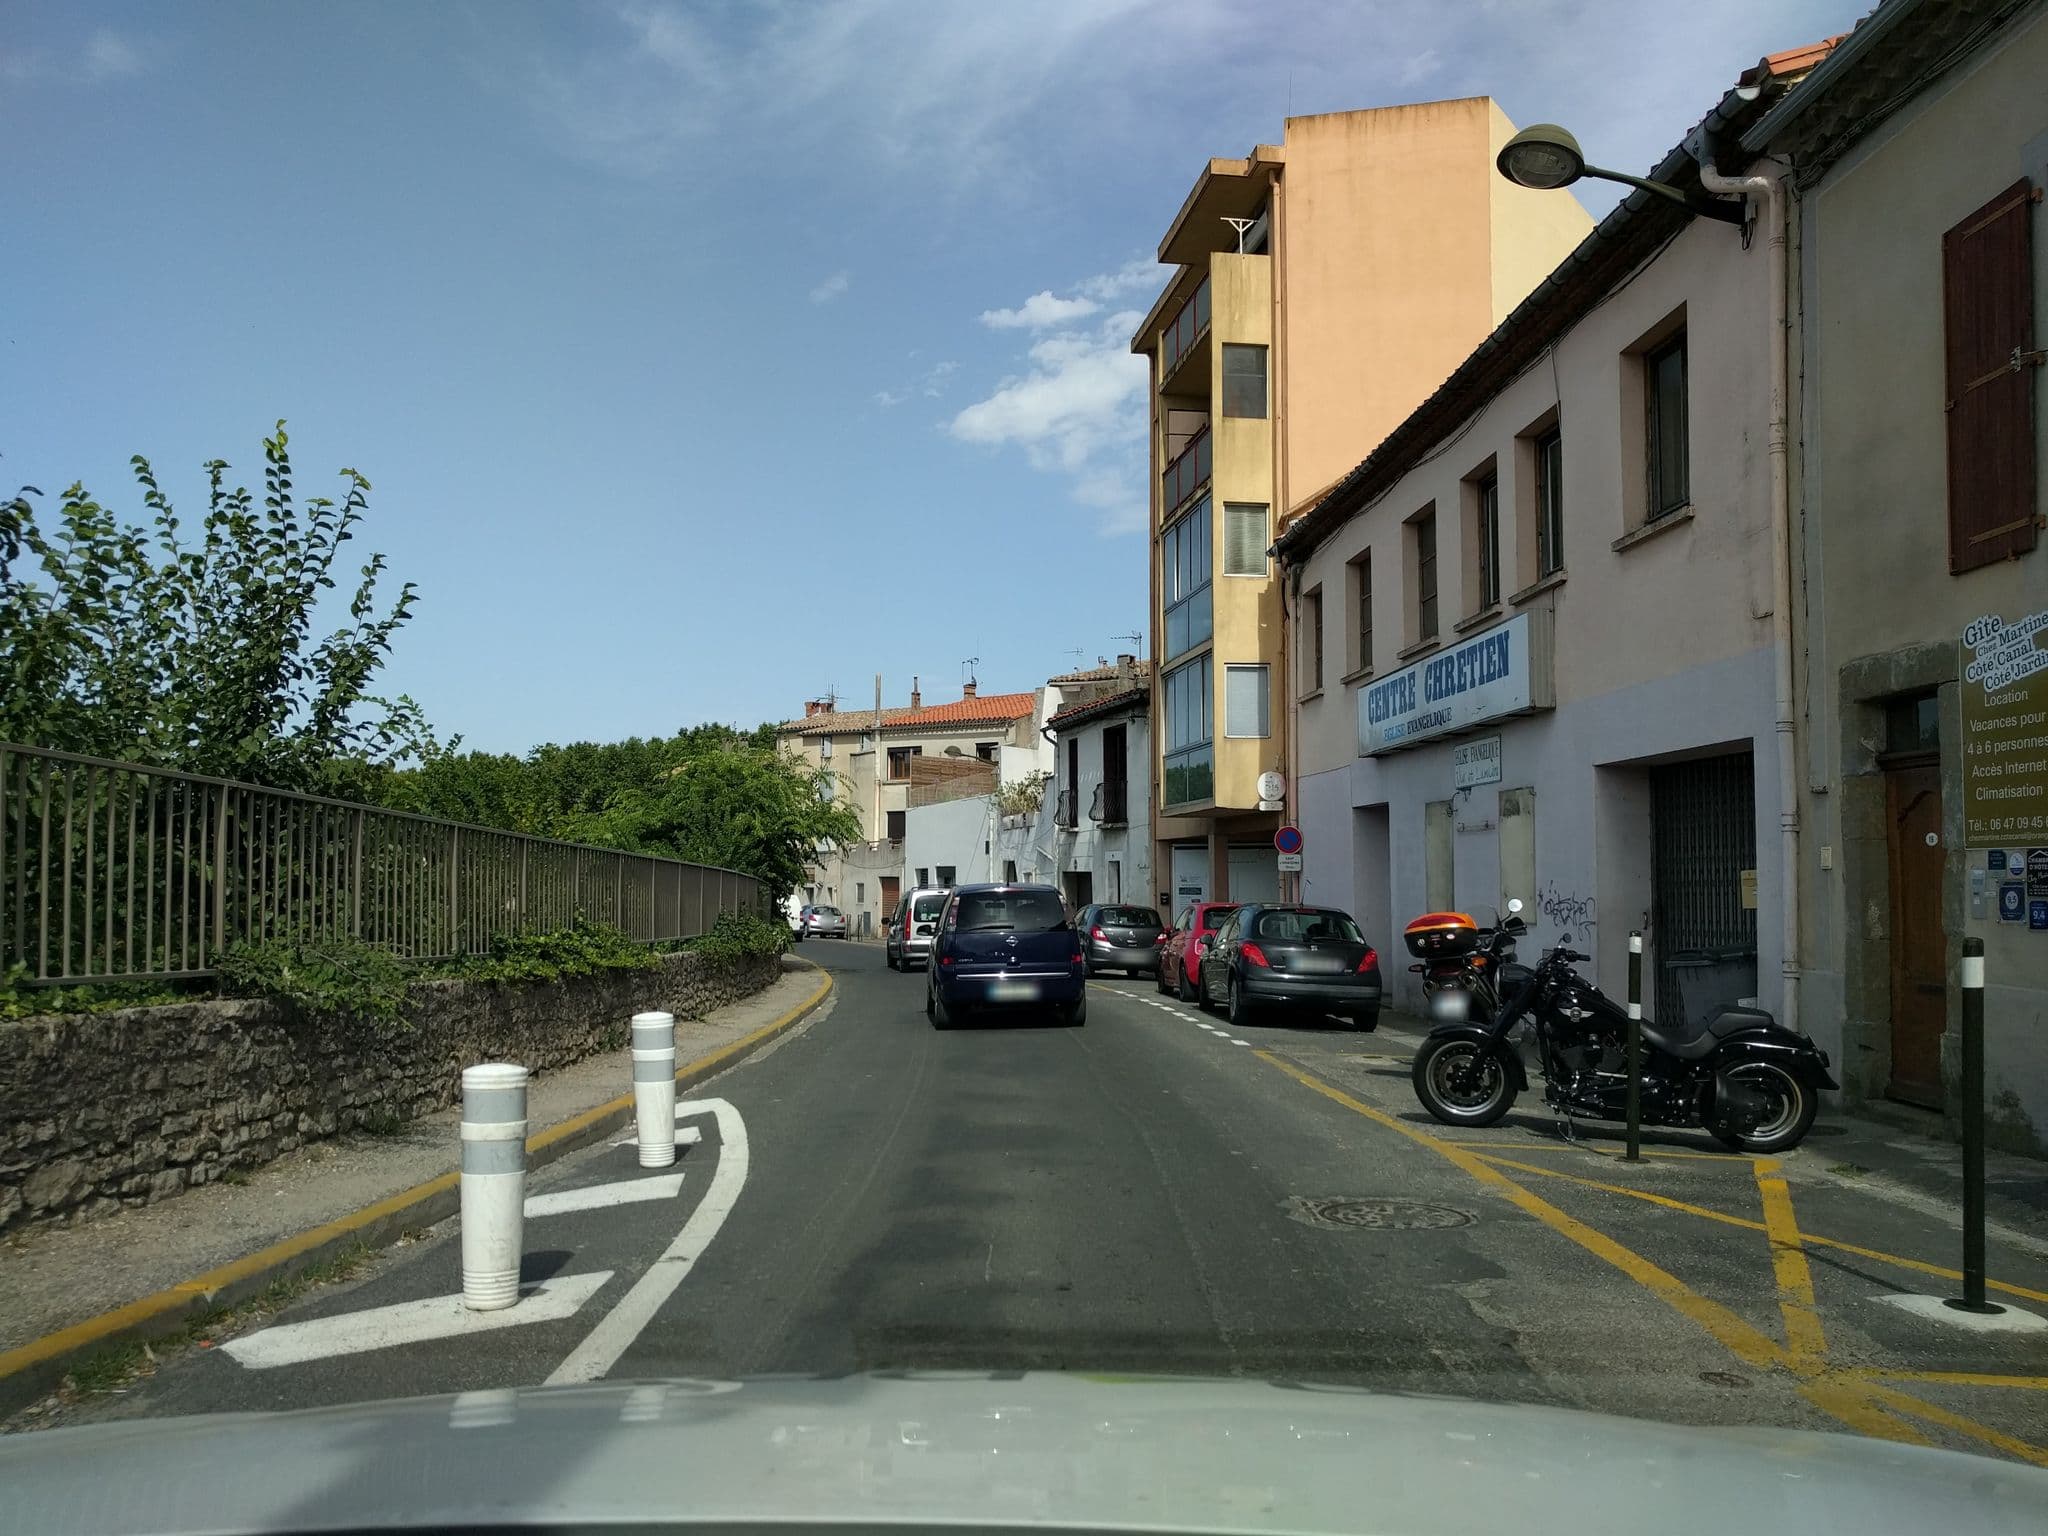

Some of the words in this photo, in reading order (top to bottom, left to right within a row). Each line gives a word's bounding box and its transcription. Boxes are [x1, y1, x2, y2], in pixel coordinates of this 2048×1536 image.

[1965, 618, 2000, 646] Gîte
[1999, 613, 2048, 647] Martine
[1967, 656, 1994, 680] Côté
[1997, 639, 2033, 666] Canal
[1368, 671, 1416, 725] CENTRE
[1424, 629, 1510, 704] CHRETIEN
[1985, 667, 2011, 690] Côté
[1984, 690, 2028, 707] Location
[1970, 716, 2017, 732] Vacances
[2020, 712, 2046, 728] pour
[1967, 743, 1974, 755] 4
[1976, 742, 1982, 755] à
[1985, 740, 1992, 753] 6
[1971, 763, 2002, 778] Accès
[2005, 759, 2047, 775] Internet
[1976, 784, 2043, 800] Climatisation
